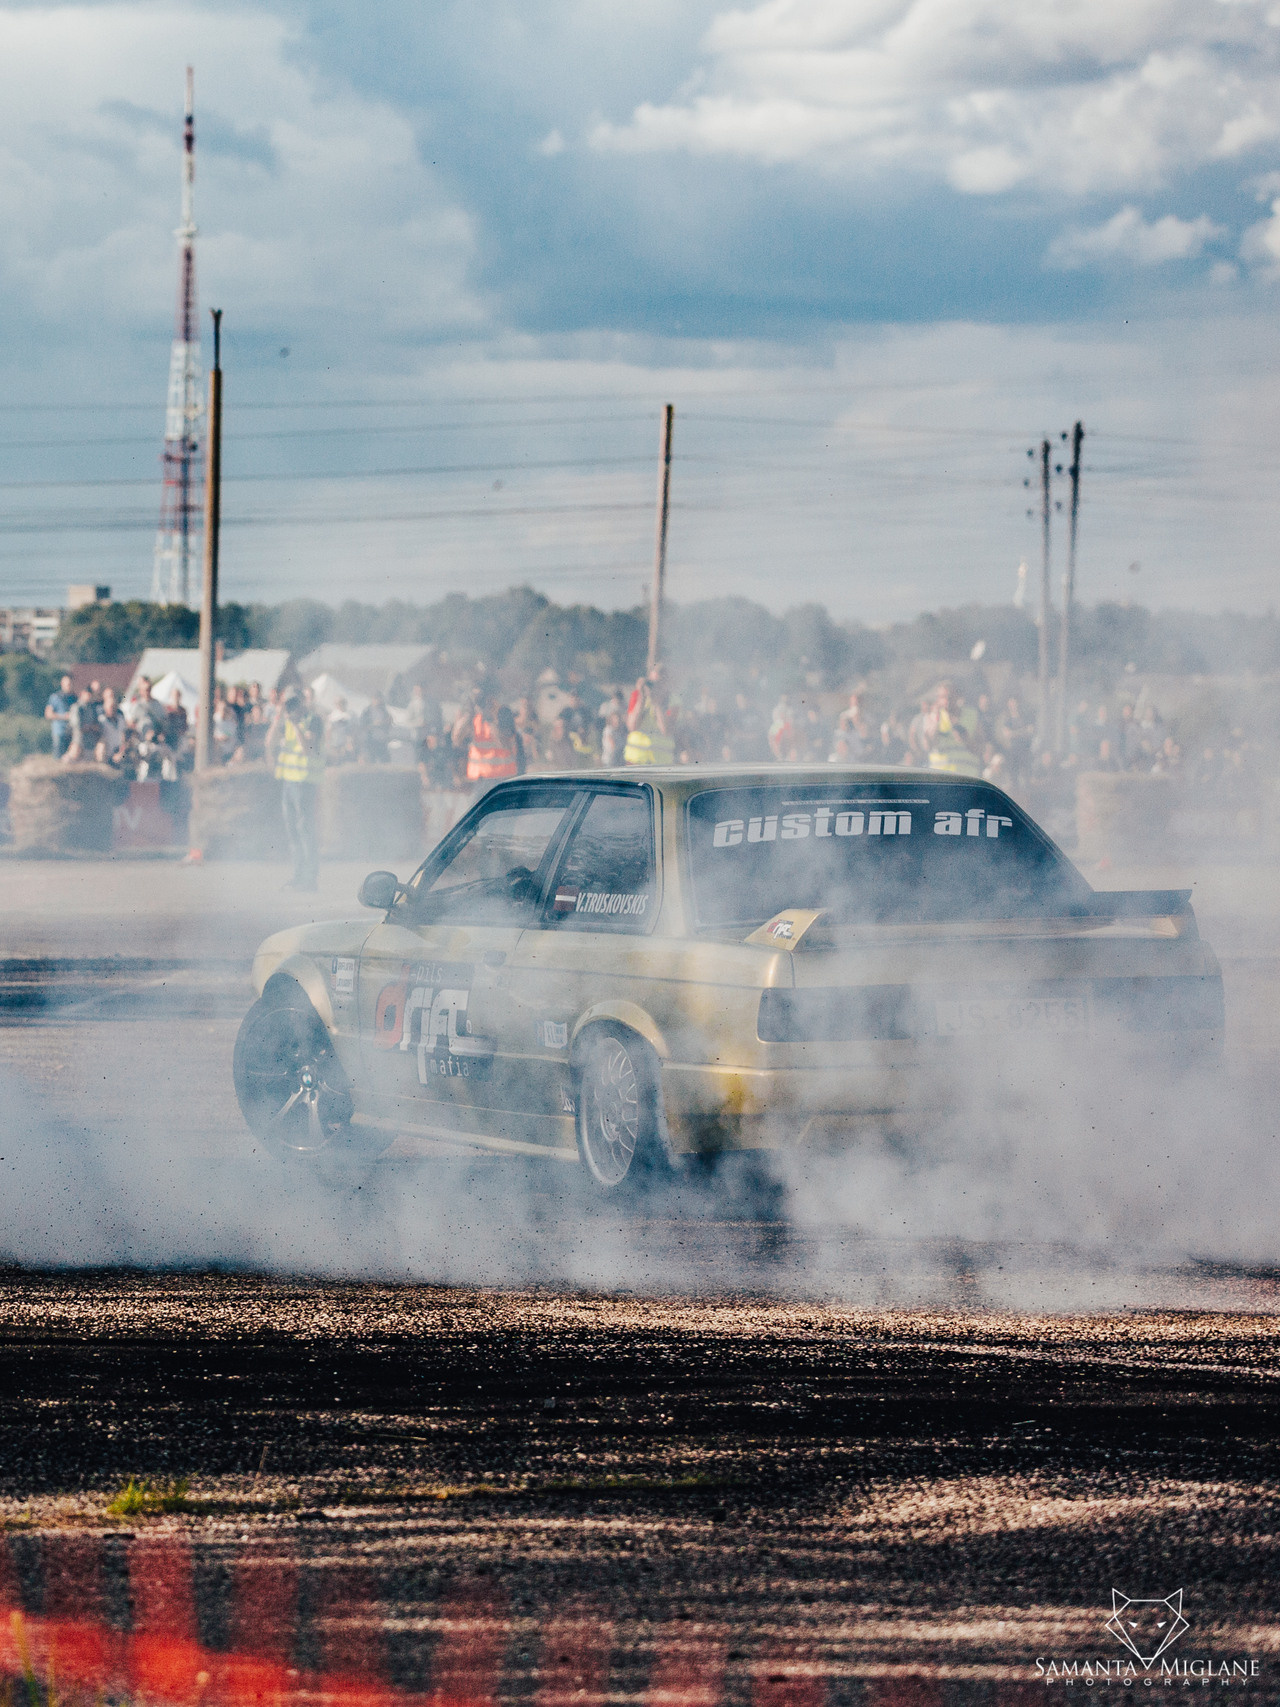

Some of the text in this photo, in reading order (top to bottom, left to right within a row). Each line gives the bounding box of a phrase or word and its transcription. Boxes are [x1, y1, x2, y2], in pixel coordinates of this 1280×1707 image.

[713, 807, 1013, 847] custom afr
[575, 892, 649, 915] V.TRUSKOVSKIS
[429, 1056, 470, 1077] mafia
